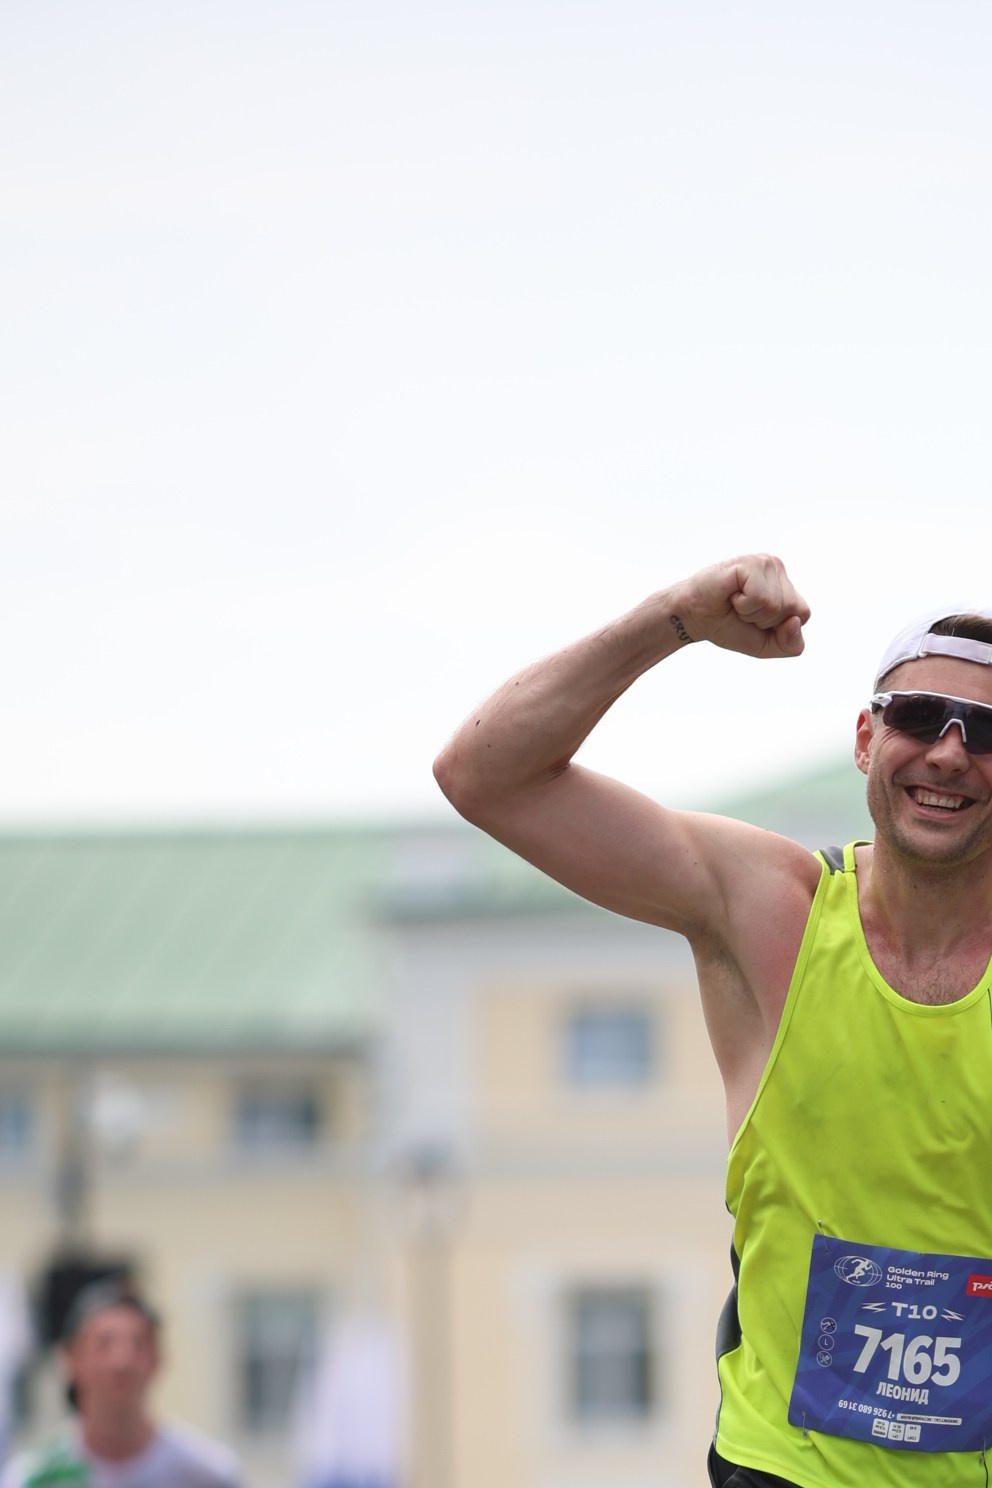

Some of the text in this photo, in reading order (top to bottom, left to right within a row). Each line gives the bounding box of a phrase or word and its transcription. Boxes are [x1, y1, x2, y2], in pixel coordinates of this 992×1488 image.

[887, 1266, 949, 1281] Golden Ring
[885, 1282, 902, 1290] 100
[886, 1274, 935, 1286] Ultra Trail
[891, 1301, 938, 1320] T10
[853, 1323, 962, 1387] 7165
[876, 1381, 930, 1405] ЛЕОНИД
[838, 1399, 848, 1409] 69
[848, 1401, 857, 1411] 31
[858, 1403, 872, 1415] 680
[873, 1407, 887, 1419] 926
[887, 1410, 895, 1419] +7
